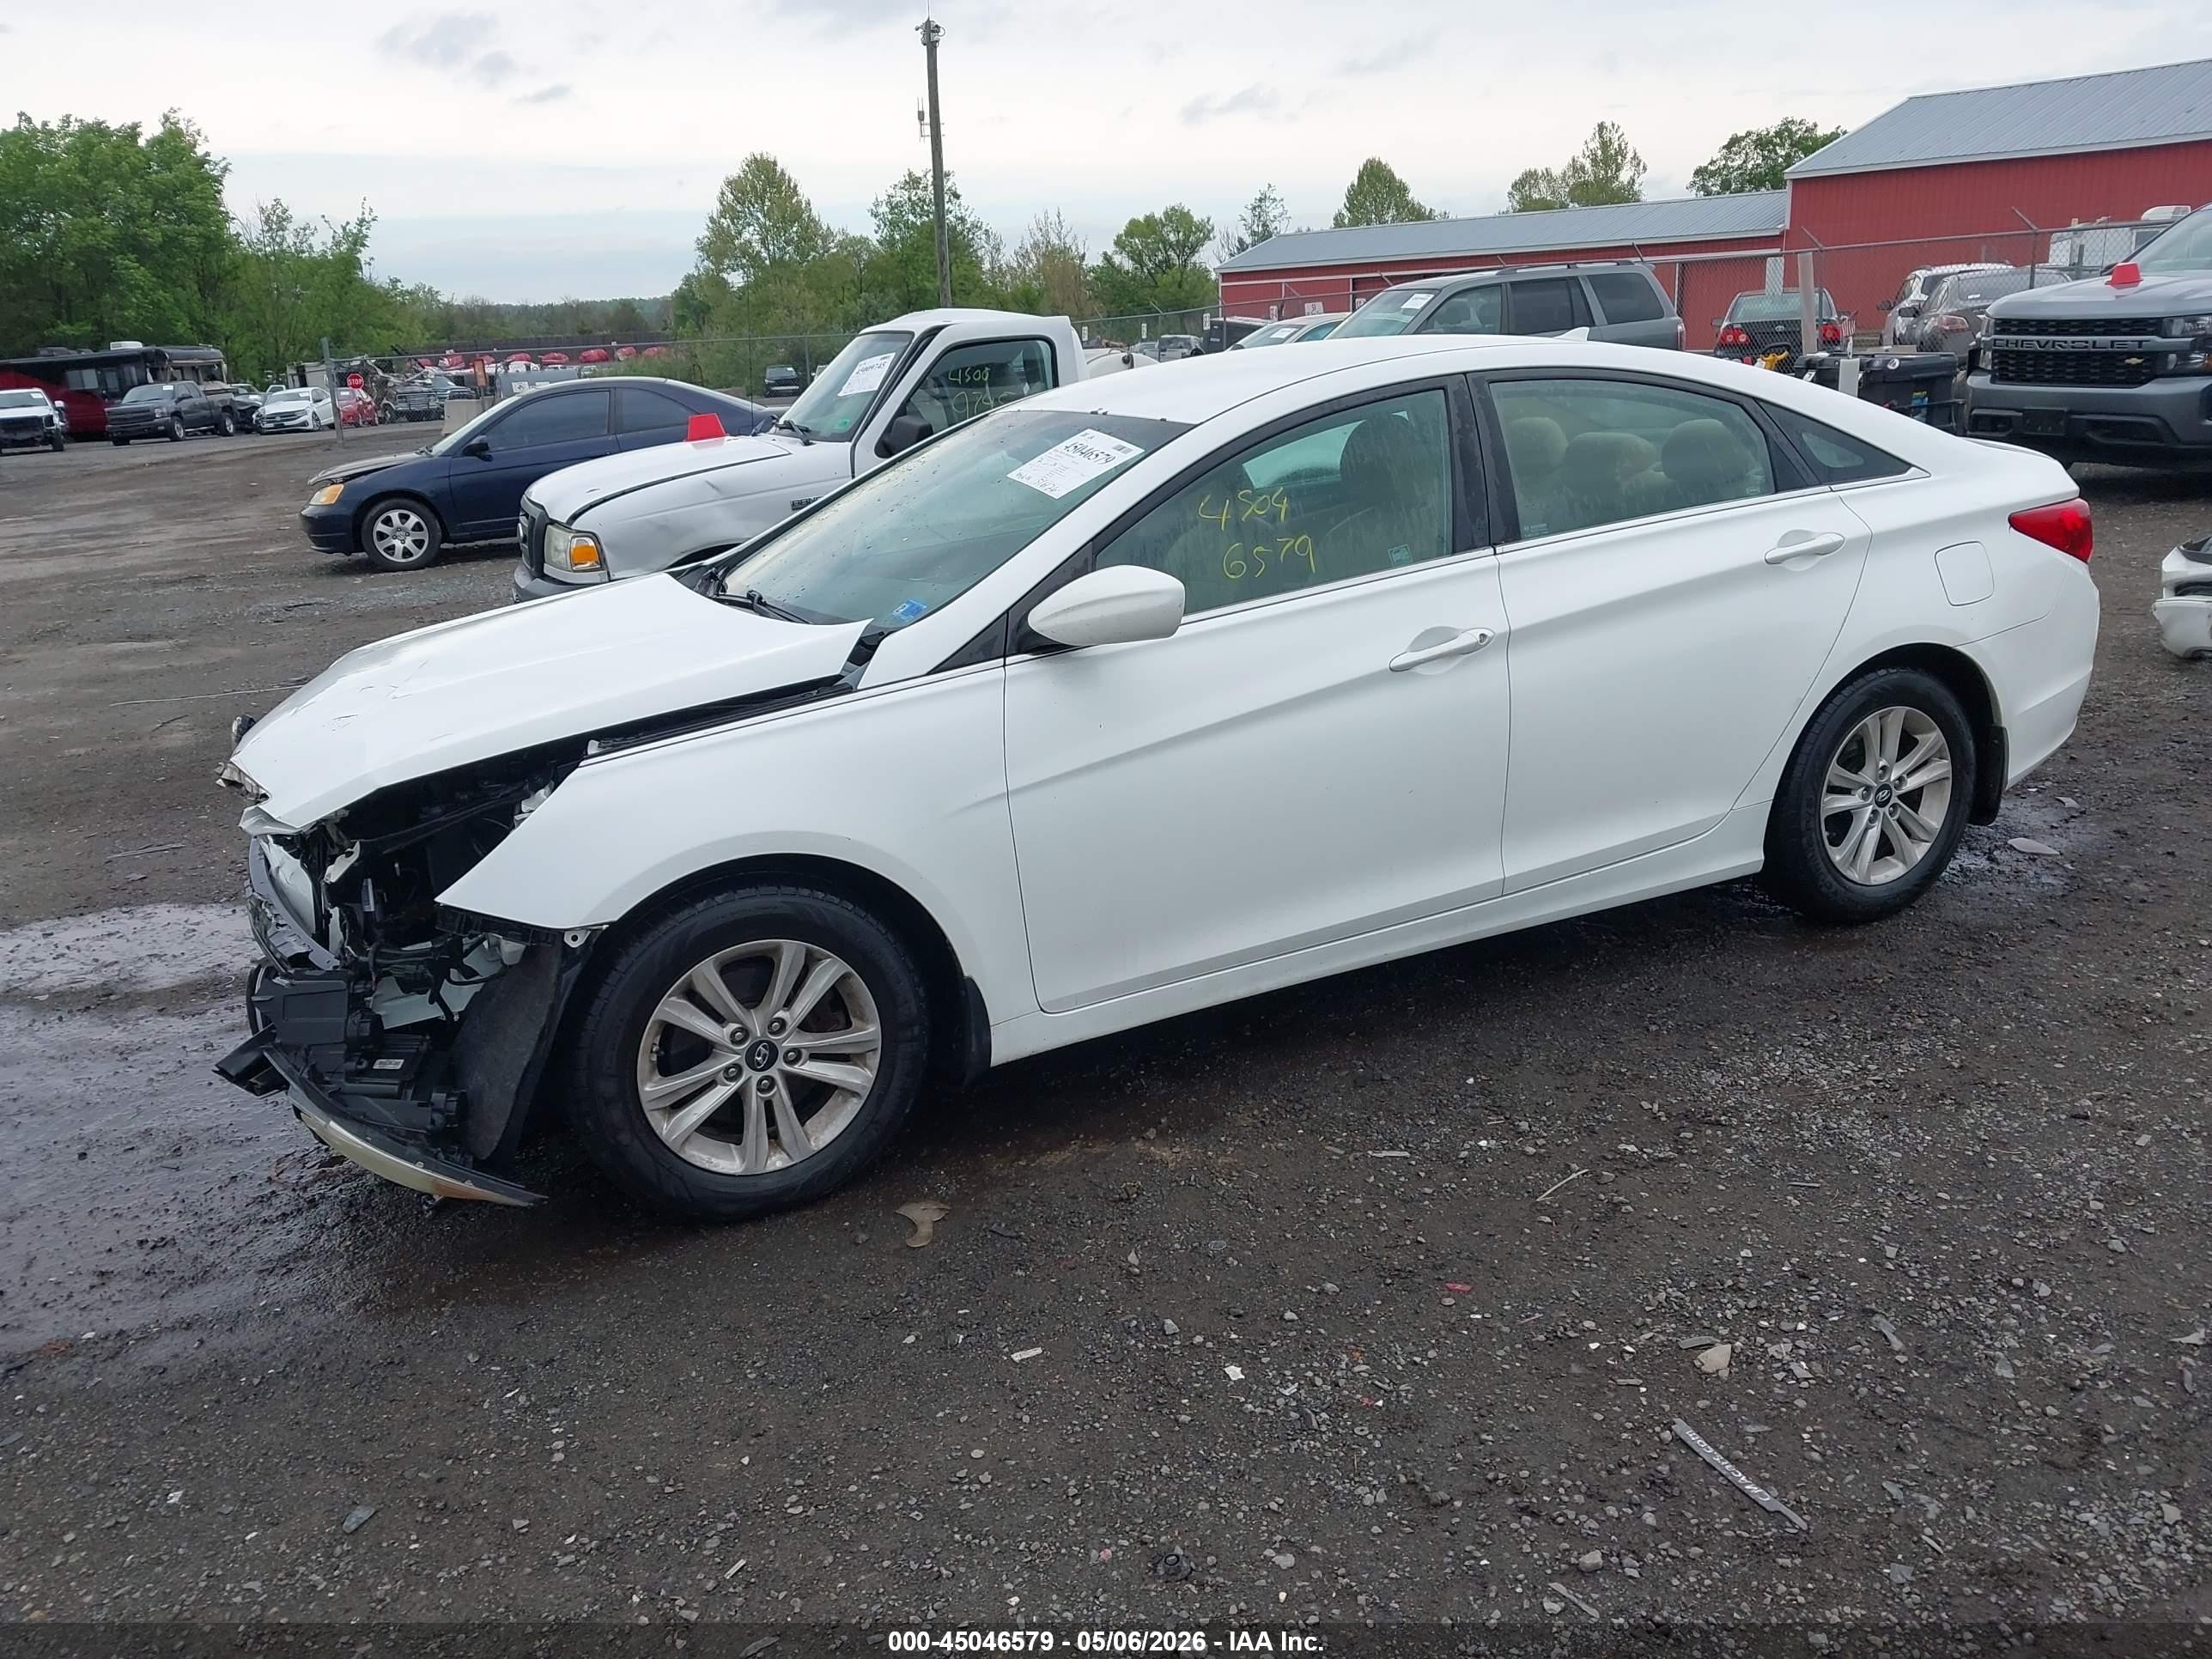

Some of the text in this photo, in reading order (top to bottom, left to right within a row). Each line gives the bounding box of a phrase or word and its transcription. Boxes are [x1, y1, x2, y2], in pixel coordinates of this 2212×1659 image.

[1993, 338, 2151, 349] CHEVROLET
[1063, 441, 1116, 465] 45046579
[1198, 486, 1288, 532] 4504
[1222, 534, 1316, 580] 6579
